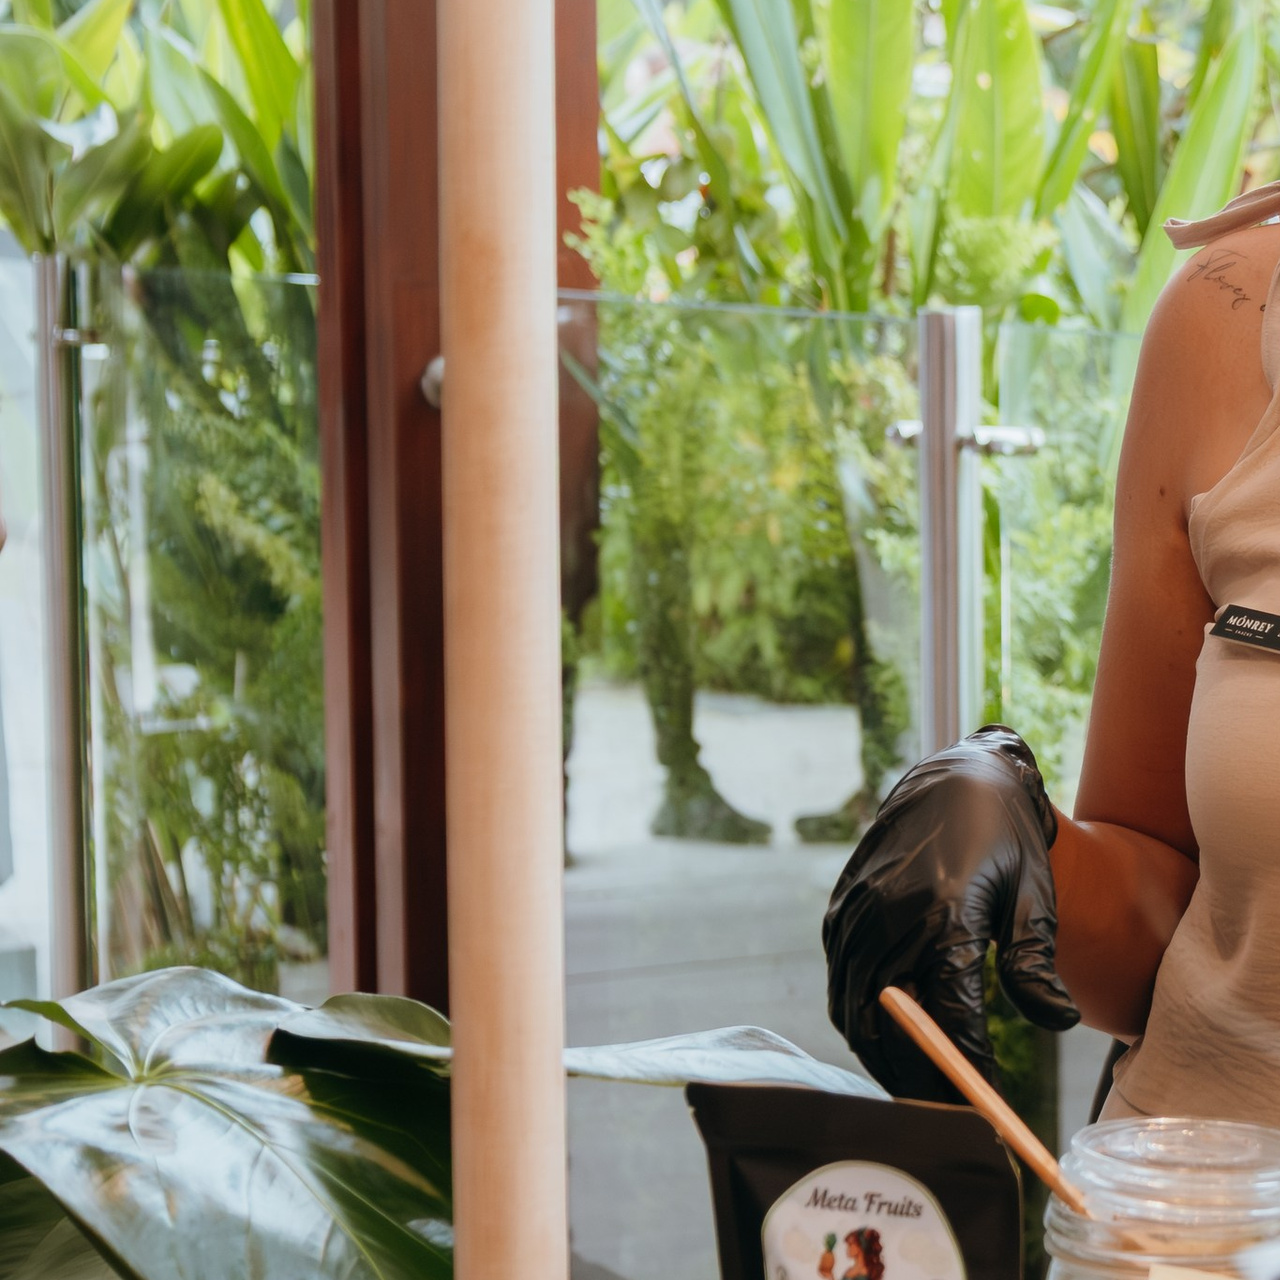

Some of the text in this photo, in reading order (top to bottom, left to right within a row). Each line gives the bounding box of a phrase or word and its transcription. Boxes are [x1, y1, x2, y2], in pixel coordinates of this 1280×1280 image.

[1226, 615, 1274, 633] MÓNREY
[804, 1187, 923, 1218] Meta Fruits
